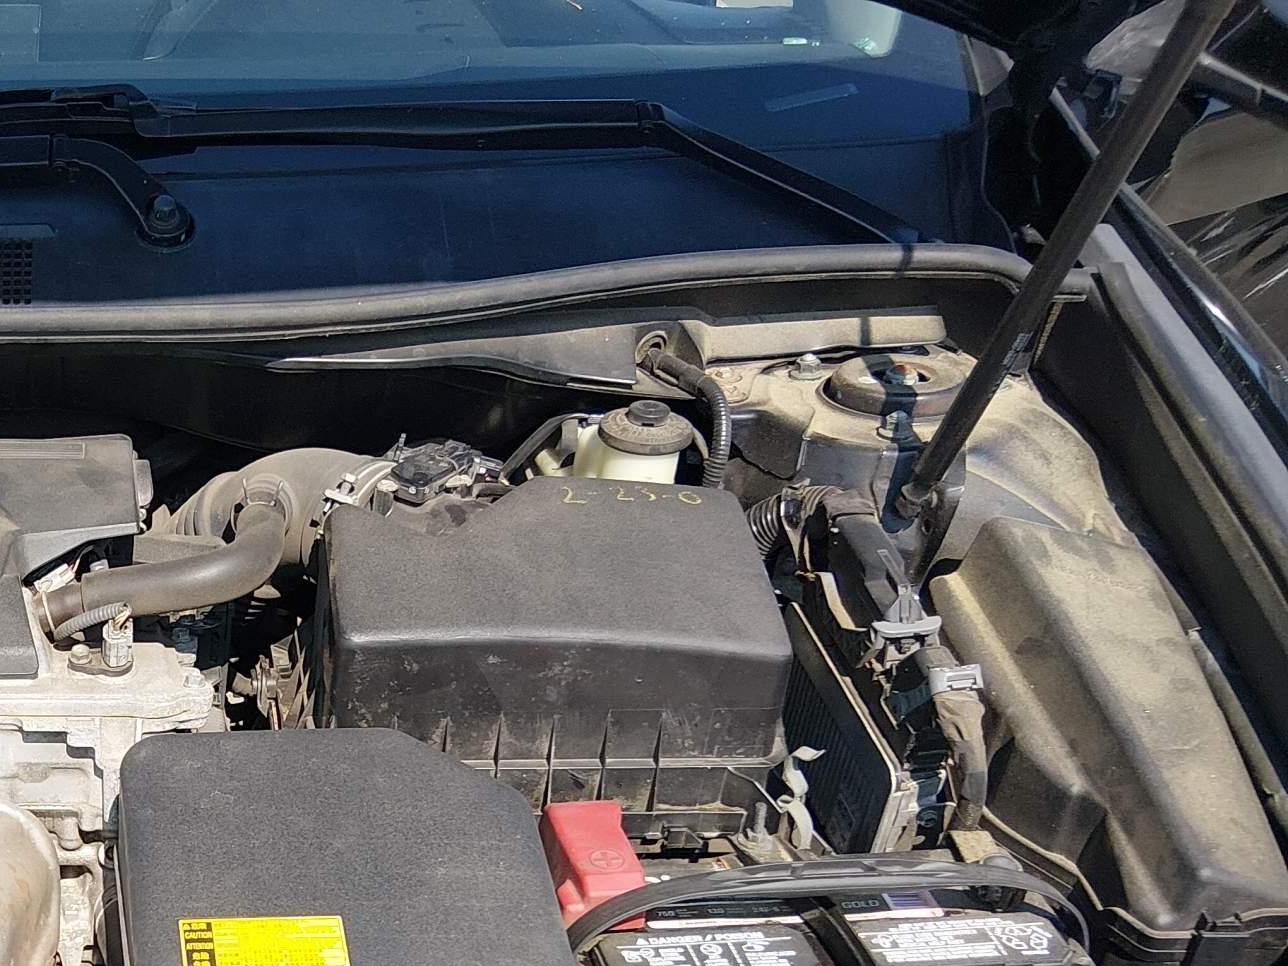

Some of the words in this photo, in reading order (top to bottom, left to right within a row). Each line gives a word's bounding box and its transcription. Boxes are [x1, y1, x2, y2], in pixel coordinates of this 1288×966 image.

[842, 899, 879, 909] GOLD
[184, 931, 212, 939] CAUTION
[648, 935, 704, 945] DANGER
[714, 931, 765, 942] POISON
